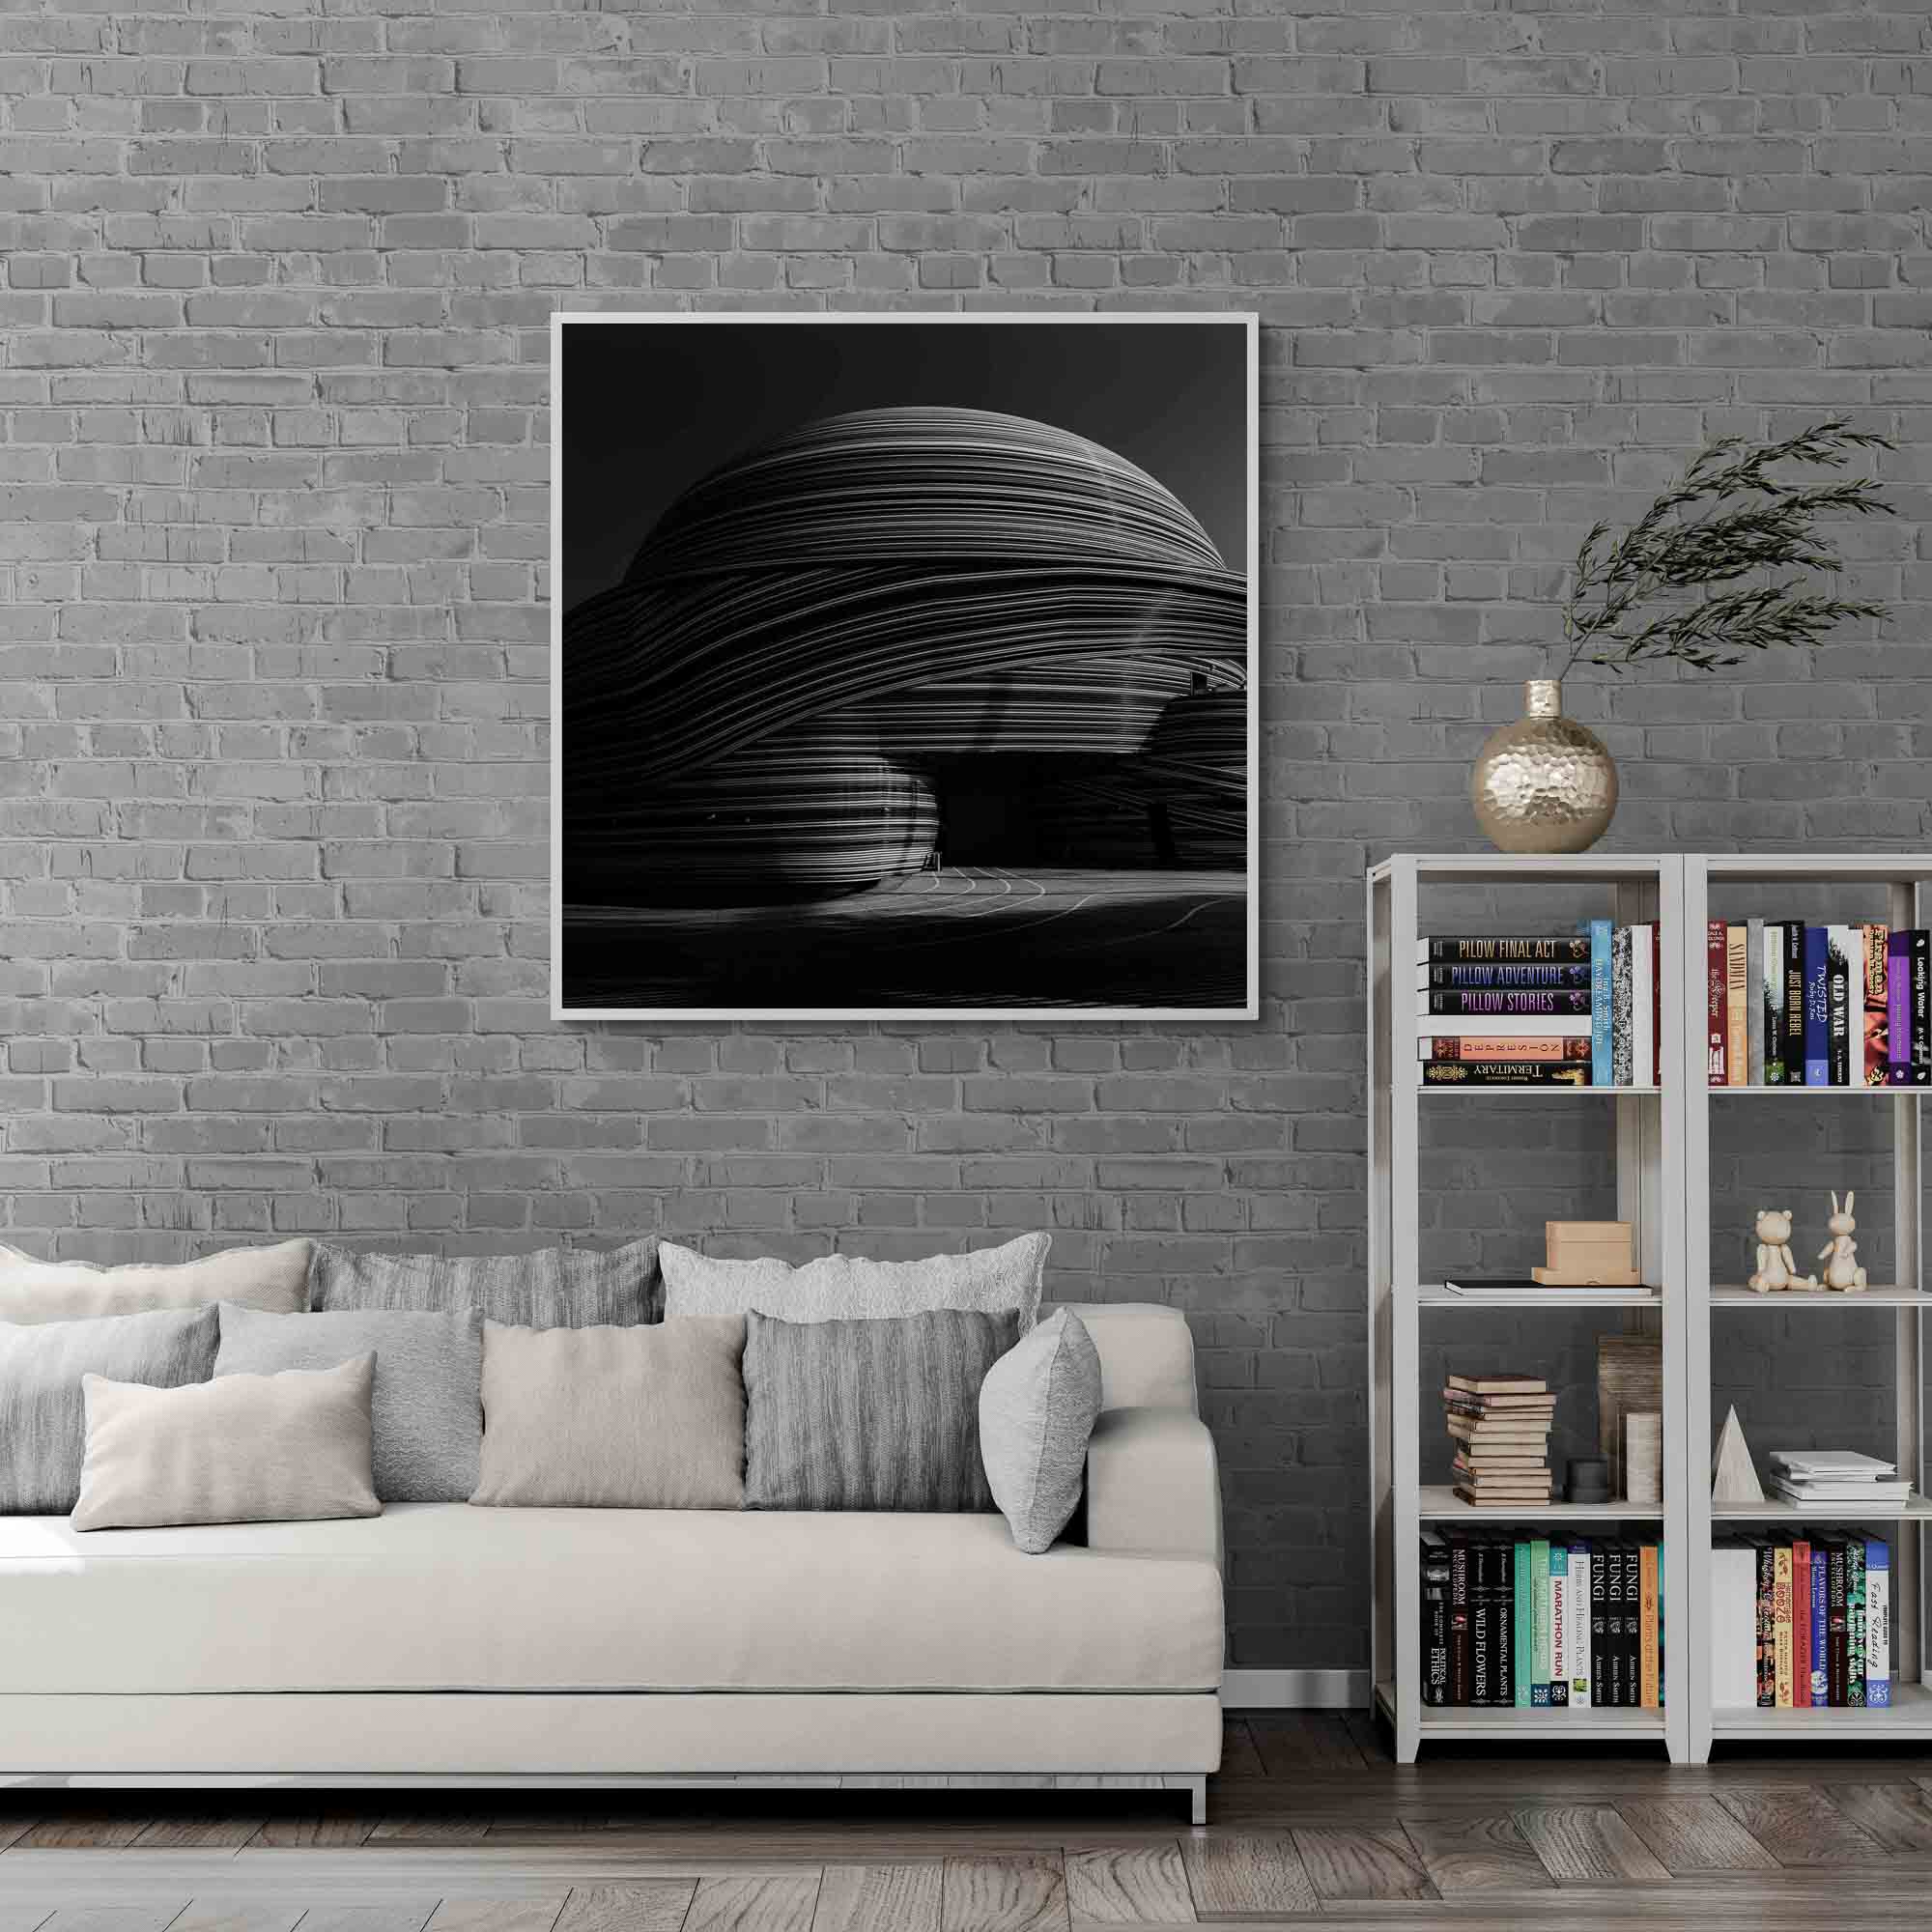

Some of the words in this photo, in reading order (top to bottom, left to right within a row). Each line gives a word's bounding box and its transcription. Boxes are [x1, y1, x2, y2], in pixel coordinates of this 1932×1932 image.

[1459, 940, 1495, 958] PILOW
[1499, 940, 1532, 958] FINAL
[1535, 940, 1555, 958] ACT
[1452, 966, 1494, 984] PILLOW
[1496, 966, 1563, 984] ADVENTURE
[1729, 943, 1747, 990] SANDMAN
[1788, 970, 1802, 988] JUST
[1462, 993, 1503, 1011] PILLOW
[1506, 993, 1554, 1011] STORIES
[1788, 990, 1802, 1011] BORN
[1817, 966, 1828, 1023] TWISTED
[1833, 974, 1845, 1001] OLD
[1917, 992, 1925, 1018] Water
[1788, 1014, 1802, 1036] REBEL
[1833, 1006, 1845, 1036] WAR
[1593, 1554, 1604, 1601] FUNGI
[1609, 1554, 1621, 1601] FUNGI
[1627, 1554, 1637, 1601] FUNGI
[1818, 1605, 1826, 1615] OF
[1870, 1582, 1881, 1611] Fast
[1476, 1607, 1486, 1638] WILD
[1554, 1580, 1563, 1648] MARATHON
[1867, 1616, 1882, 1668] Reading
[1476, 1641, 1486, 1696] FLOWERS
[1554, 1652, 1563, 1677] RUN
